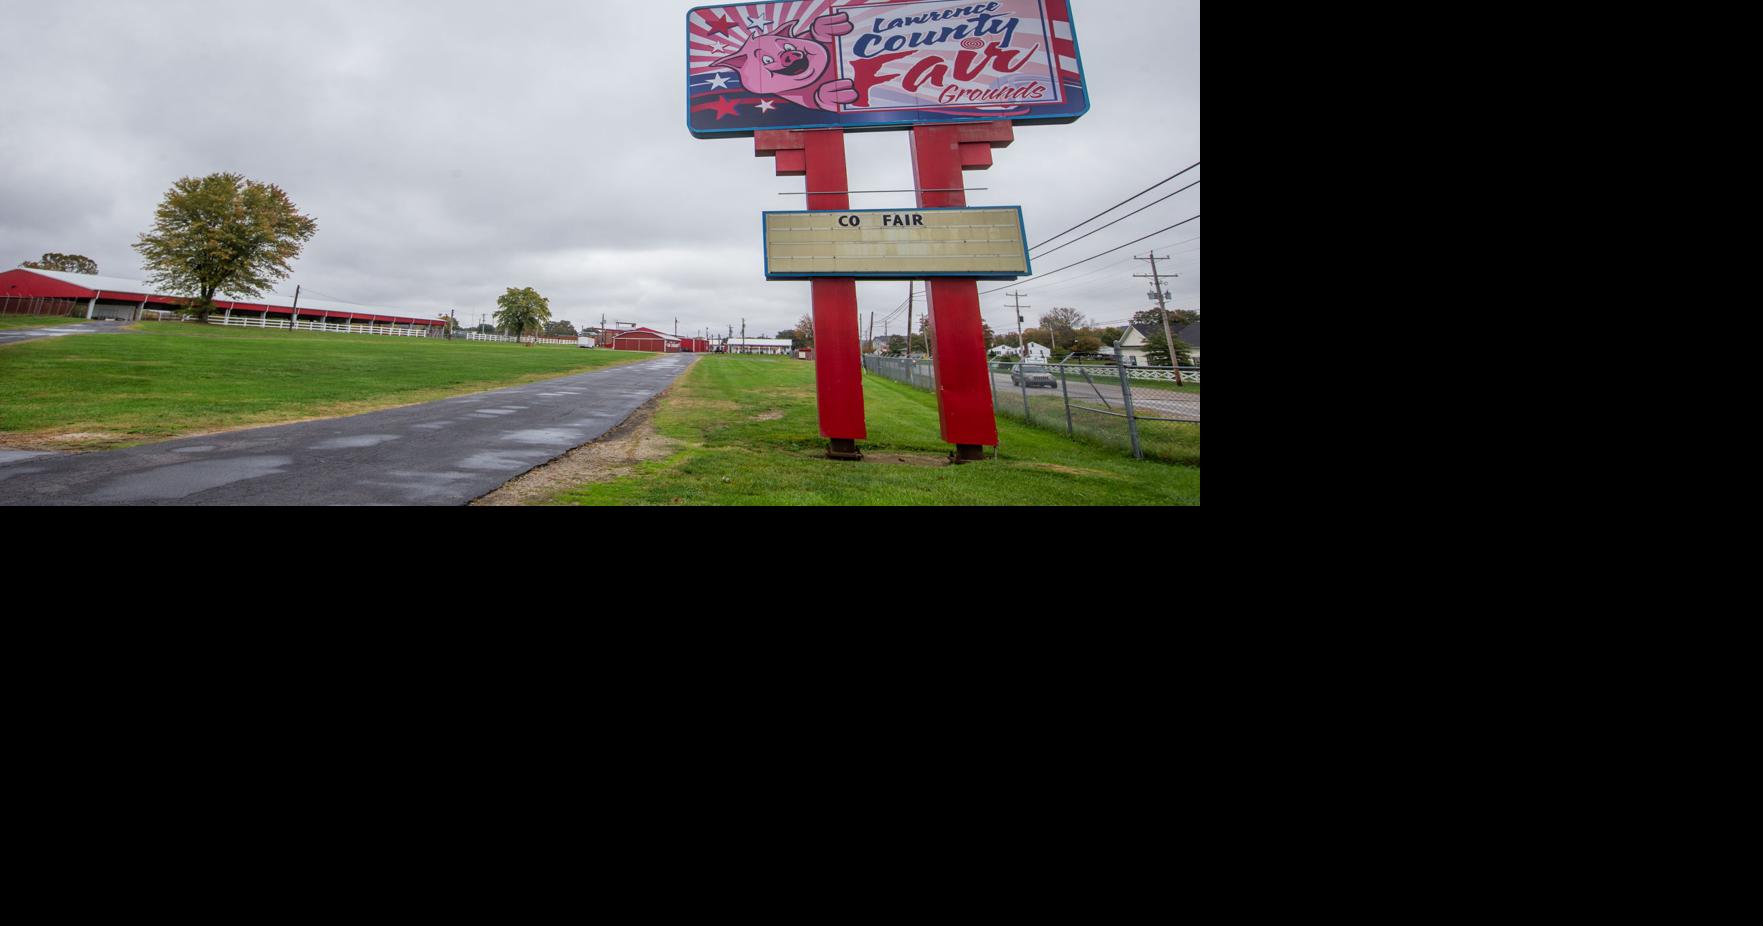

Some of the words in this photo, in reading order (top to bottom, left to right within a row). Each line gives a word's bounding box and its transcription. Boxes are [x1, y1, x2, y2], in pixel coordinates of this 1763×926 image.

[873, 1, 1000, 33] Lawrence
[854, 12, 1019, 57] County
[850, 39, 1038, 107] Fair
[939, 81, 1045, 103] Grounds
[838, 215, 860, 227] CO
[882, 214, 923, 226] FAIR
